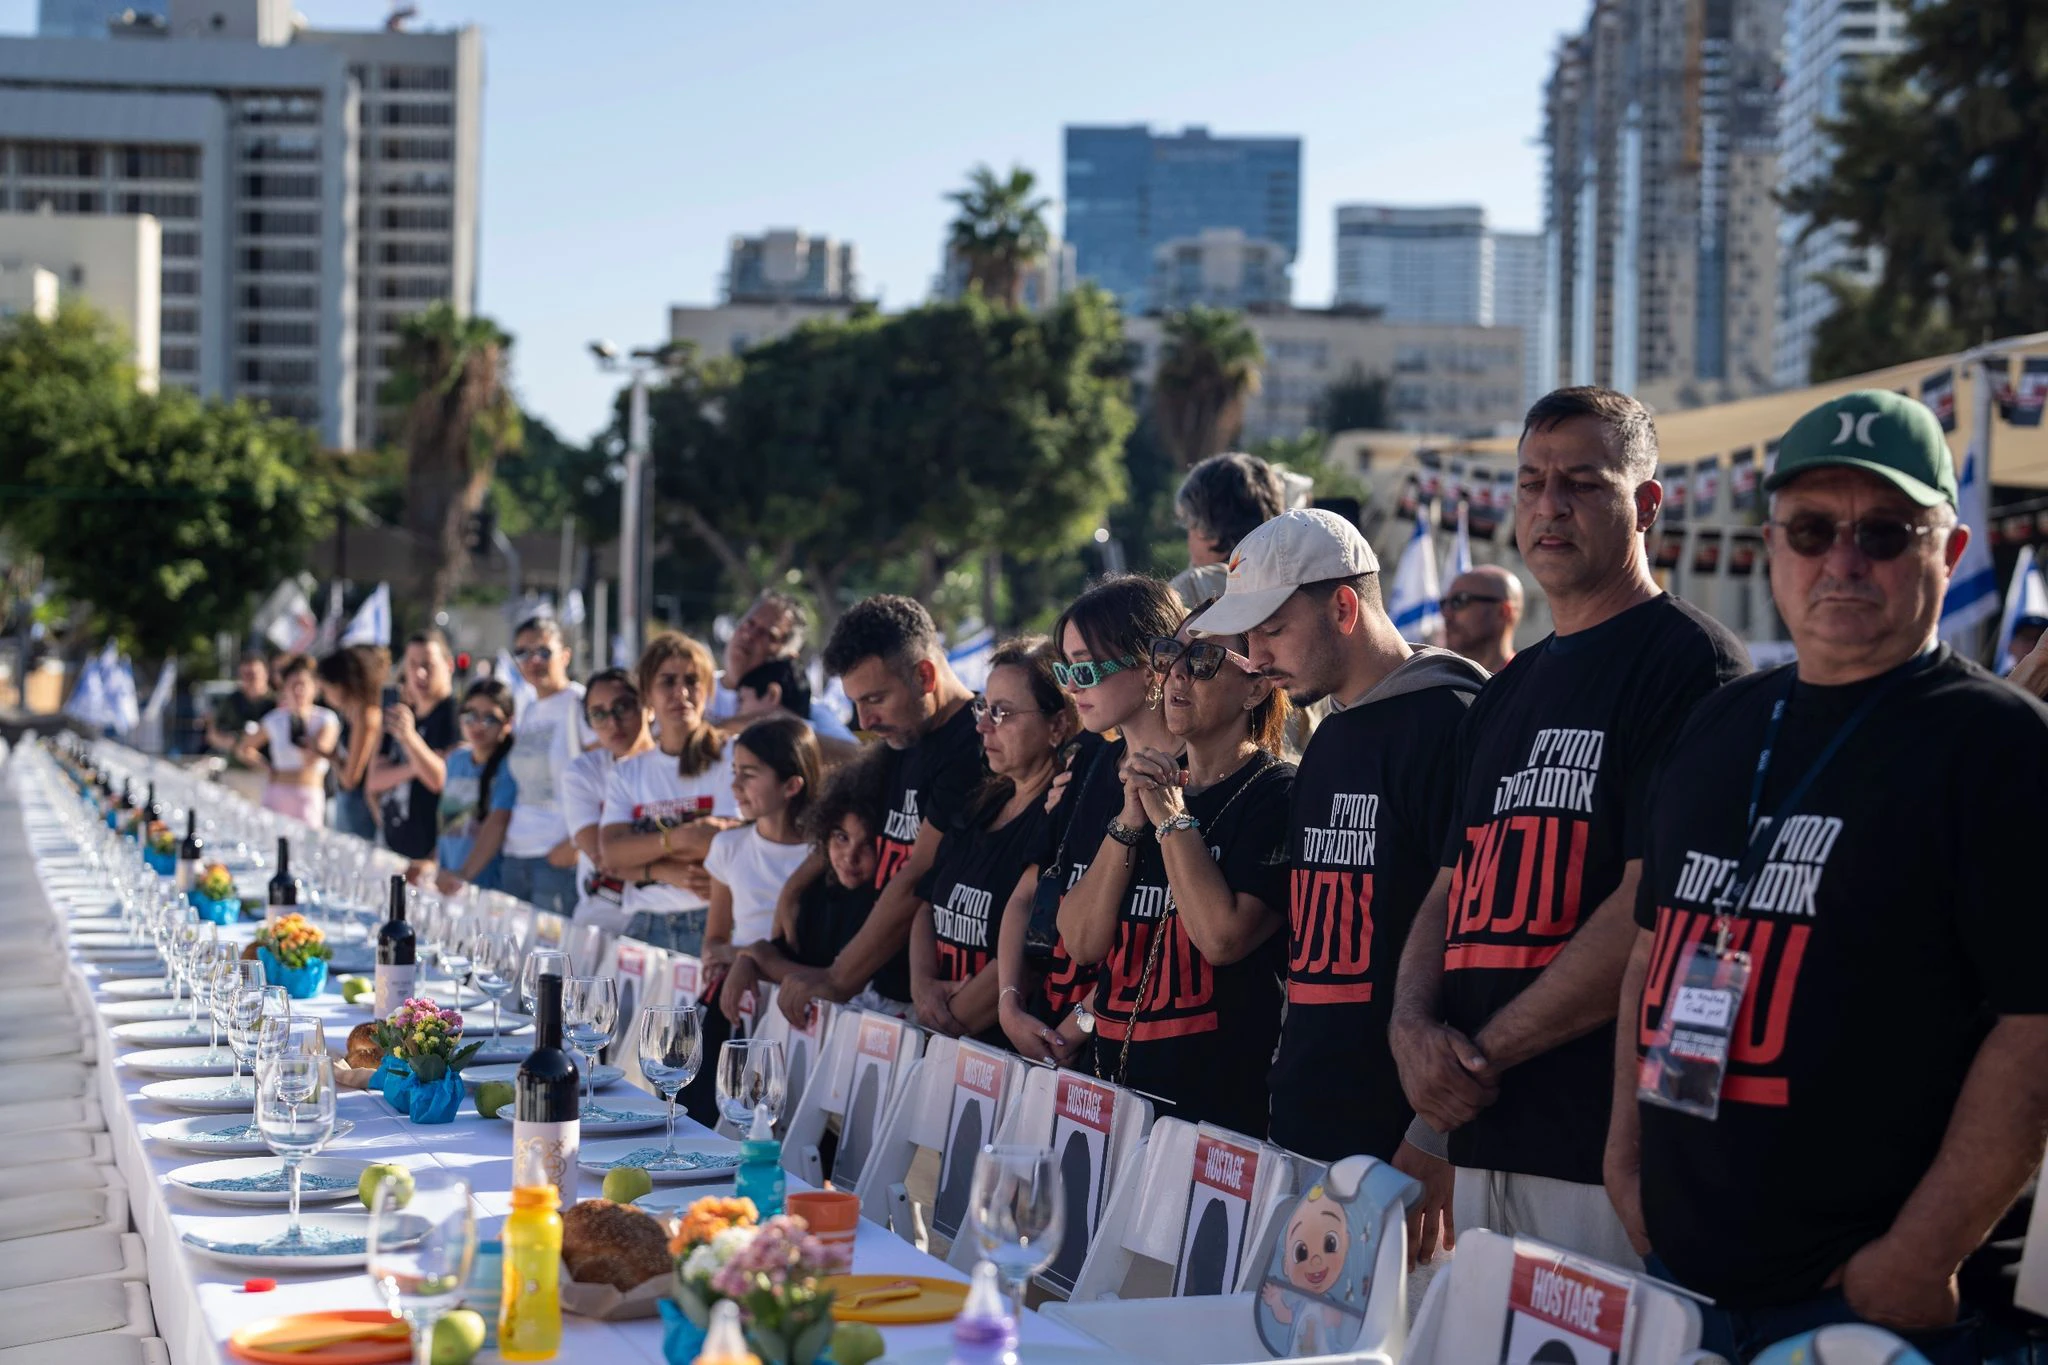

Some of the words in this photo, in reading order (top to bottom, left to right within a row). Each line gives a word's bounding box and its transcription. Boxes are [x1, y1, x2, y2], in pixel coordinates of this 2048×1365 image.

[1527, 728, 1605, 770] מחזירים
[1535, 767, 1597, 813] אותם
[1333, 829, 1377, 866] אותם
[1749, 814, 1844, 864] מחזיר
[1749, 862, 1823, 916] אותם
[953, 912, 988, 947] אותם
[963, 1055, 996, 1092] HOSTAGE
[1065, 1083, 1103, 1124] HOSTAGE
[1204, 1146, 1245, 1190] HOSTAGE
[1530, 1266, 1605, 1334] HOSTAGE
